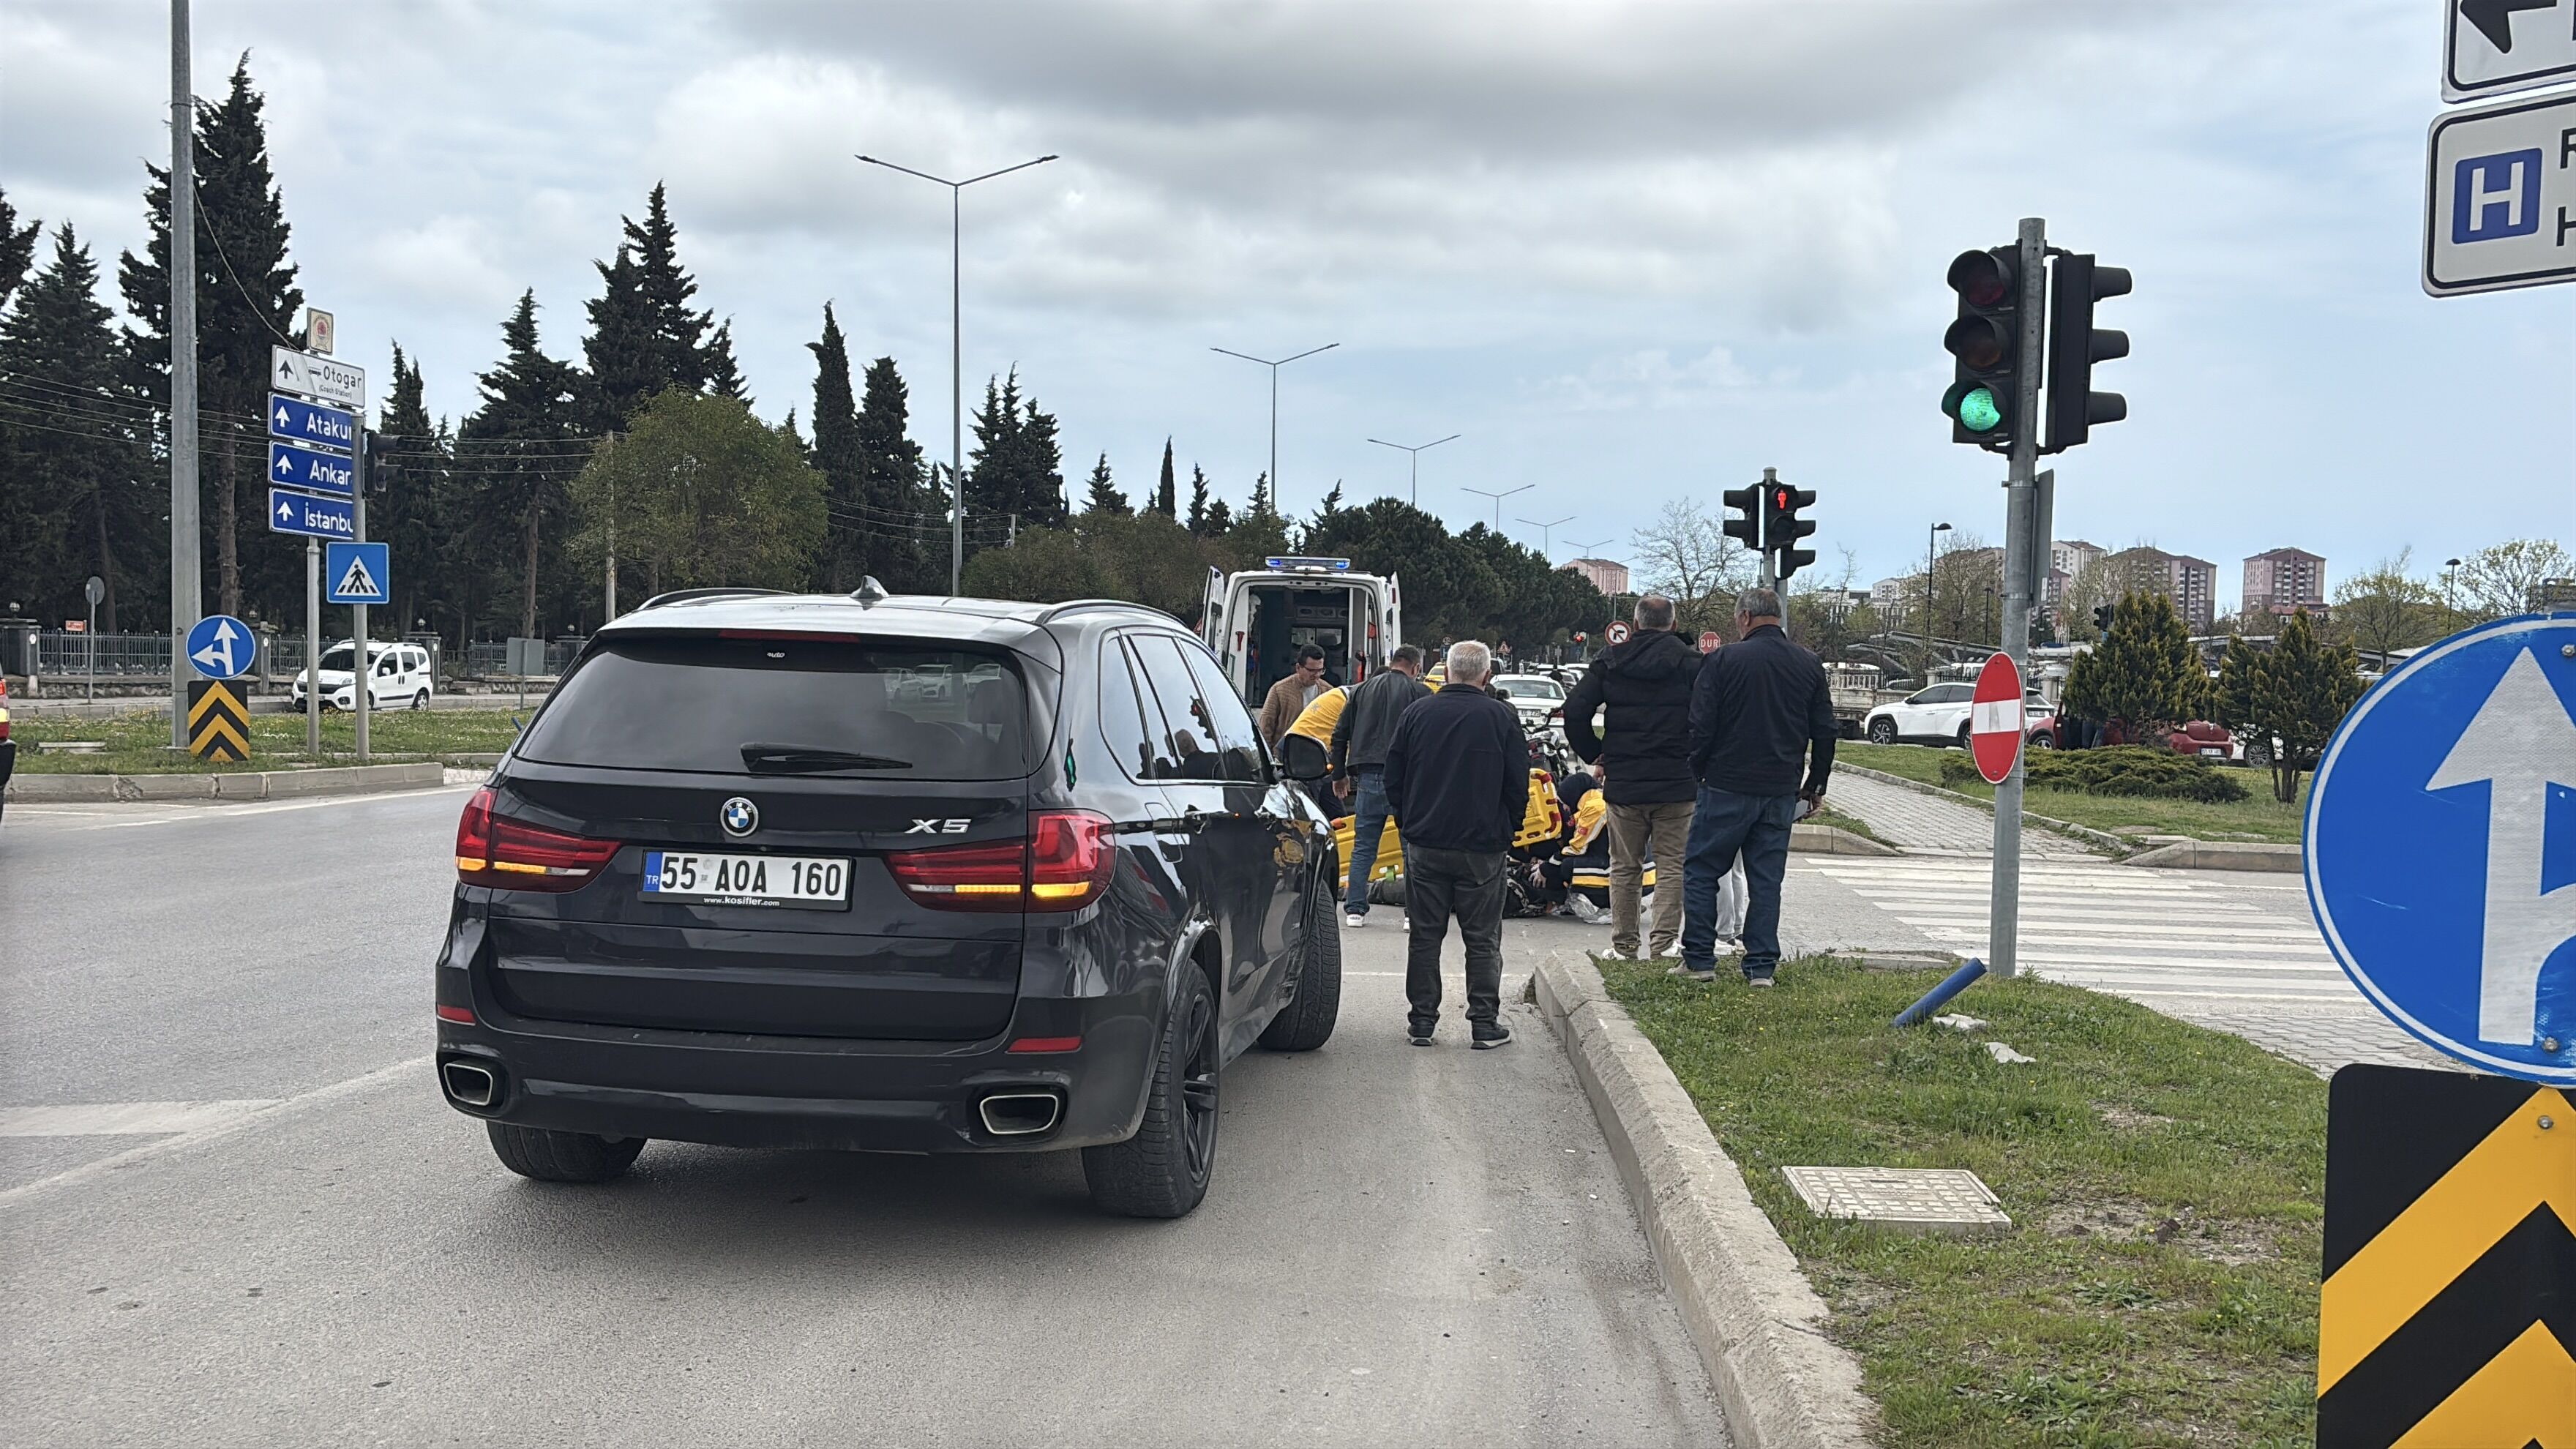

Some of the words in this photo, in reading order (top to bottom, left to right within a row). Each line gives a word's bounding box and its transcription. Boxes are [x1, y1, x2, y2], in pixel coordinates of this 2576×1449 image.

[2469, 161, 2525, 232] H
[323, 365, 362, 389] Otogar
[310, 460, 353, 486] Ankar
[1701, 639, 1718, 648] DUR
[904, 819, 972, 834] X5
[646, 875, 659, 885] TR
[662, 856, 698, 889] 55
[715, 859, 767, 892] AOA
[792, 861, 842, 896] 160
